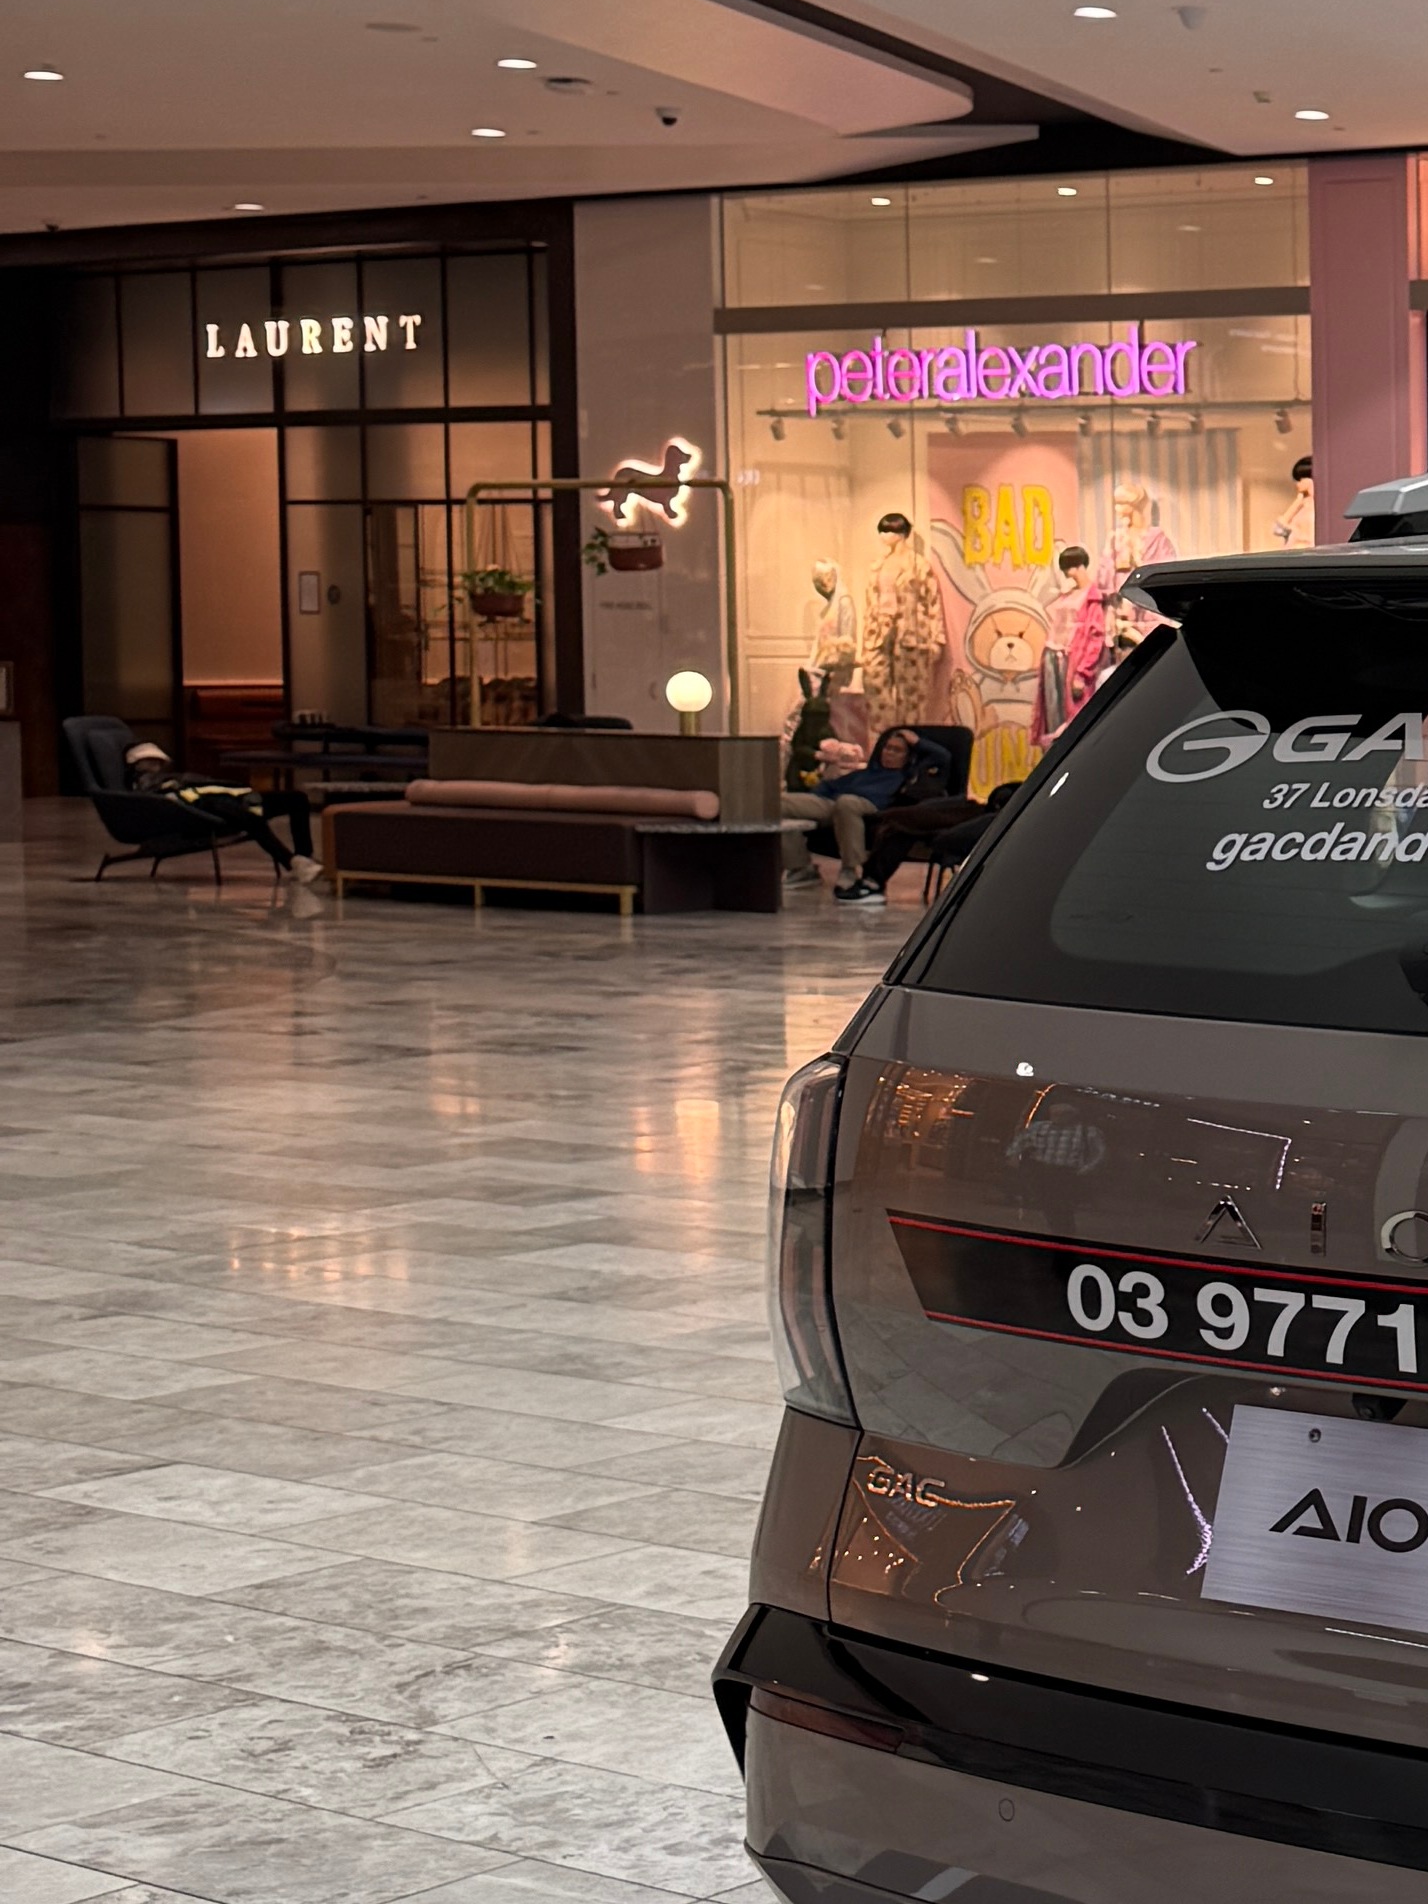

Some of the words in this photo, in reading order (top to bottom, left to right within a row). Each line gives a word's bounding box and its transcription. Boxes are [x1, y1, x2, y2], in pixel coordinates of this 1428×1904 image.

[206, 314, 421, 358] LAURENT
[806, 324, 1197, 417] peteralexander
[963, 482, 1053, 568] BAD
[1262, 782, 1311, 809] 37
[1066, 1263, 1169, 1340] 03
[1196, 1281, 1419, 1375] 9771
[867, 1465, 945, 1507] GAC
